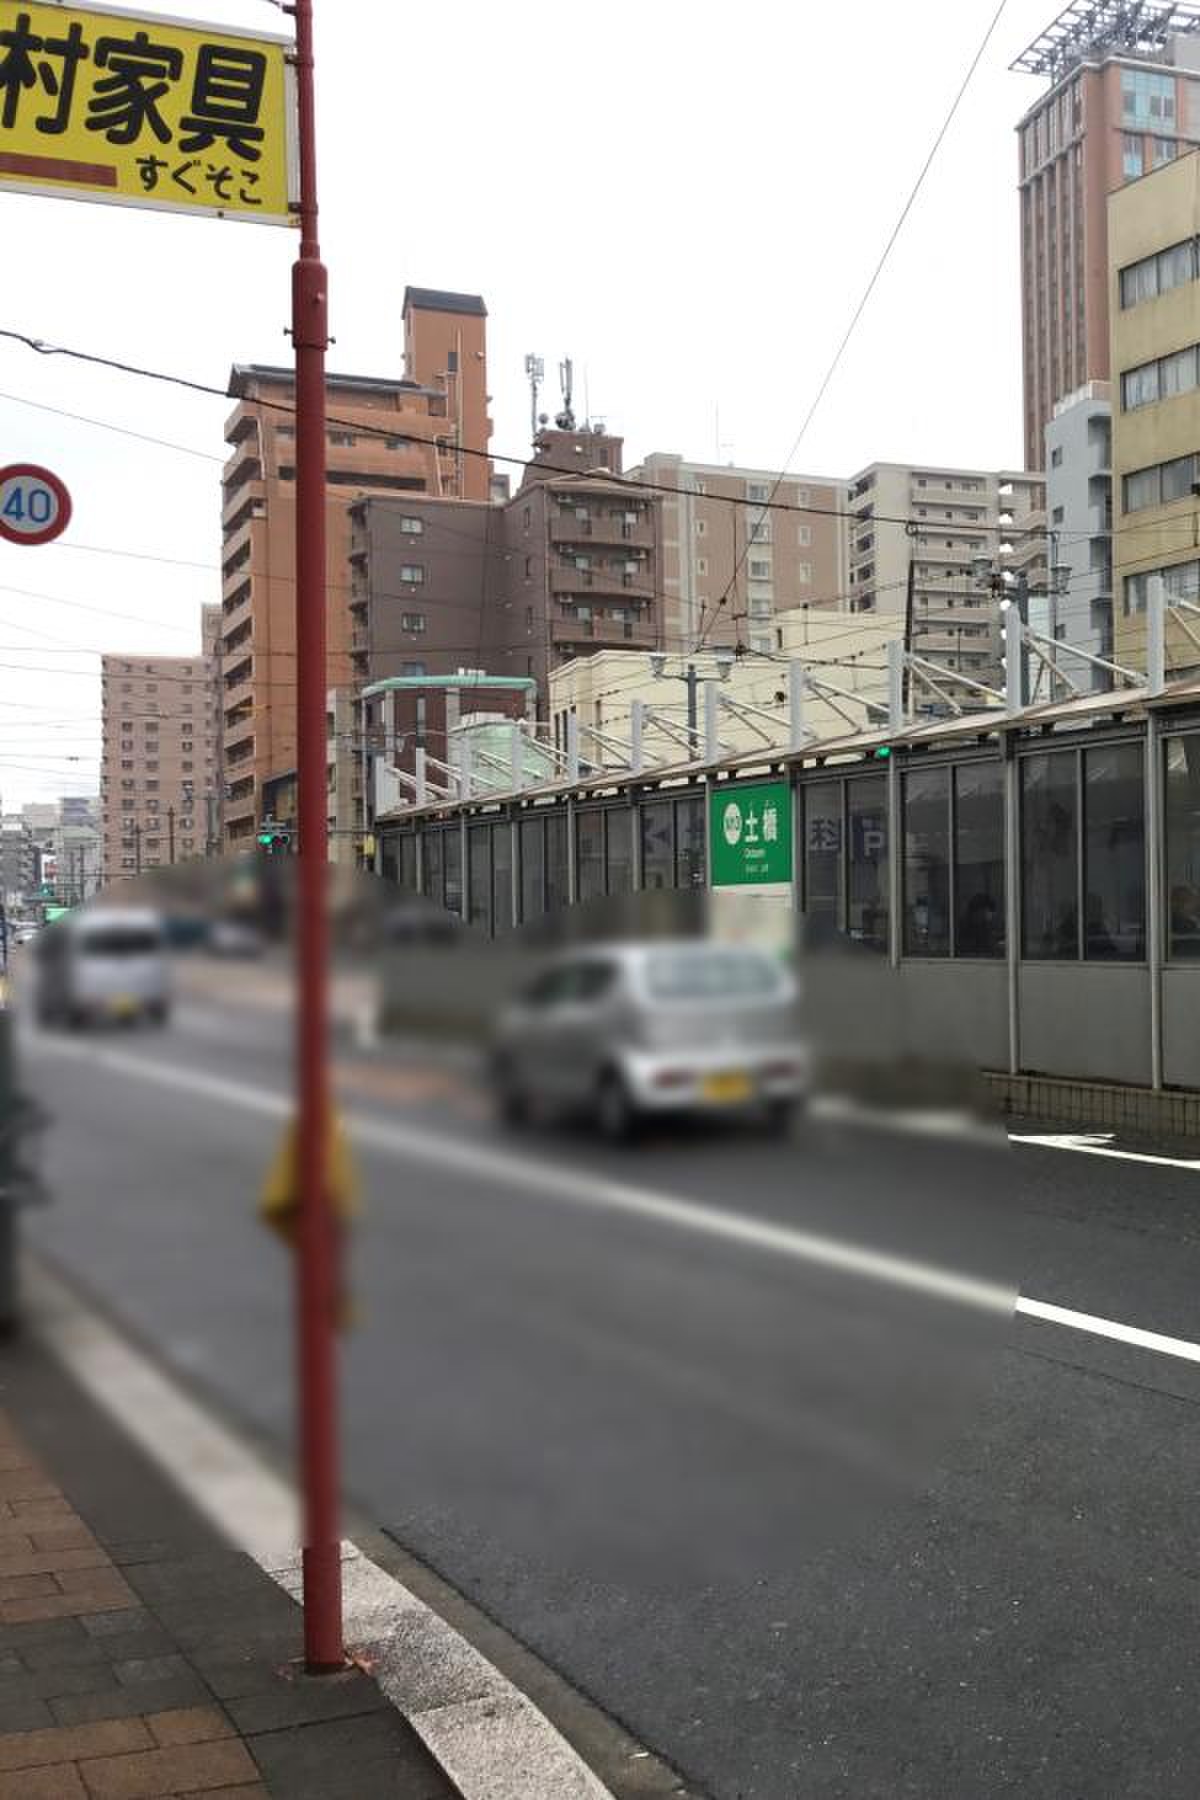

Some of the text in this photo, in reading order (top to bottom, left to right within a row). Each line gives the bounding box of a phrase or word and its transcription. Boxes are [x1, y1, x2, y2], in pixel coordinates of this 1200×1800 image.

[0, 13, 266, 161] 村家具
[136, 154, 262, 204] すぐそこ
[3, 487, 50, 522] 40
